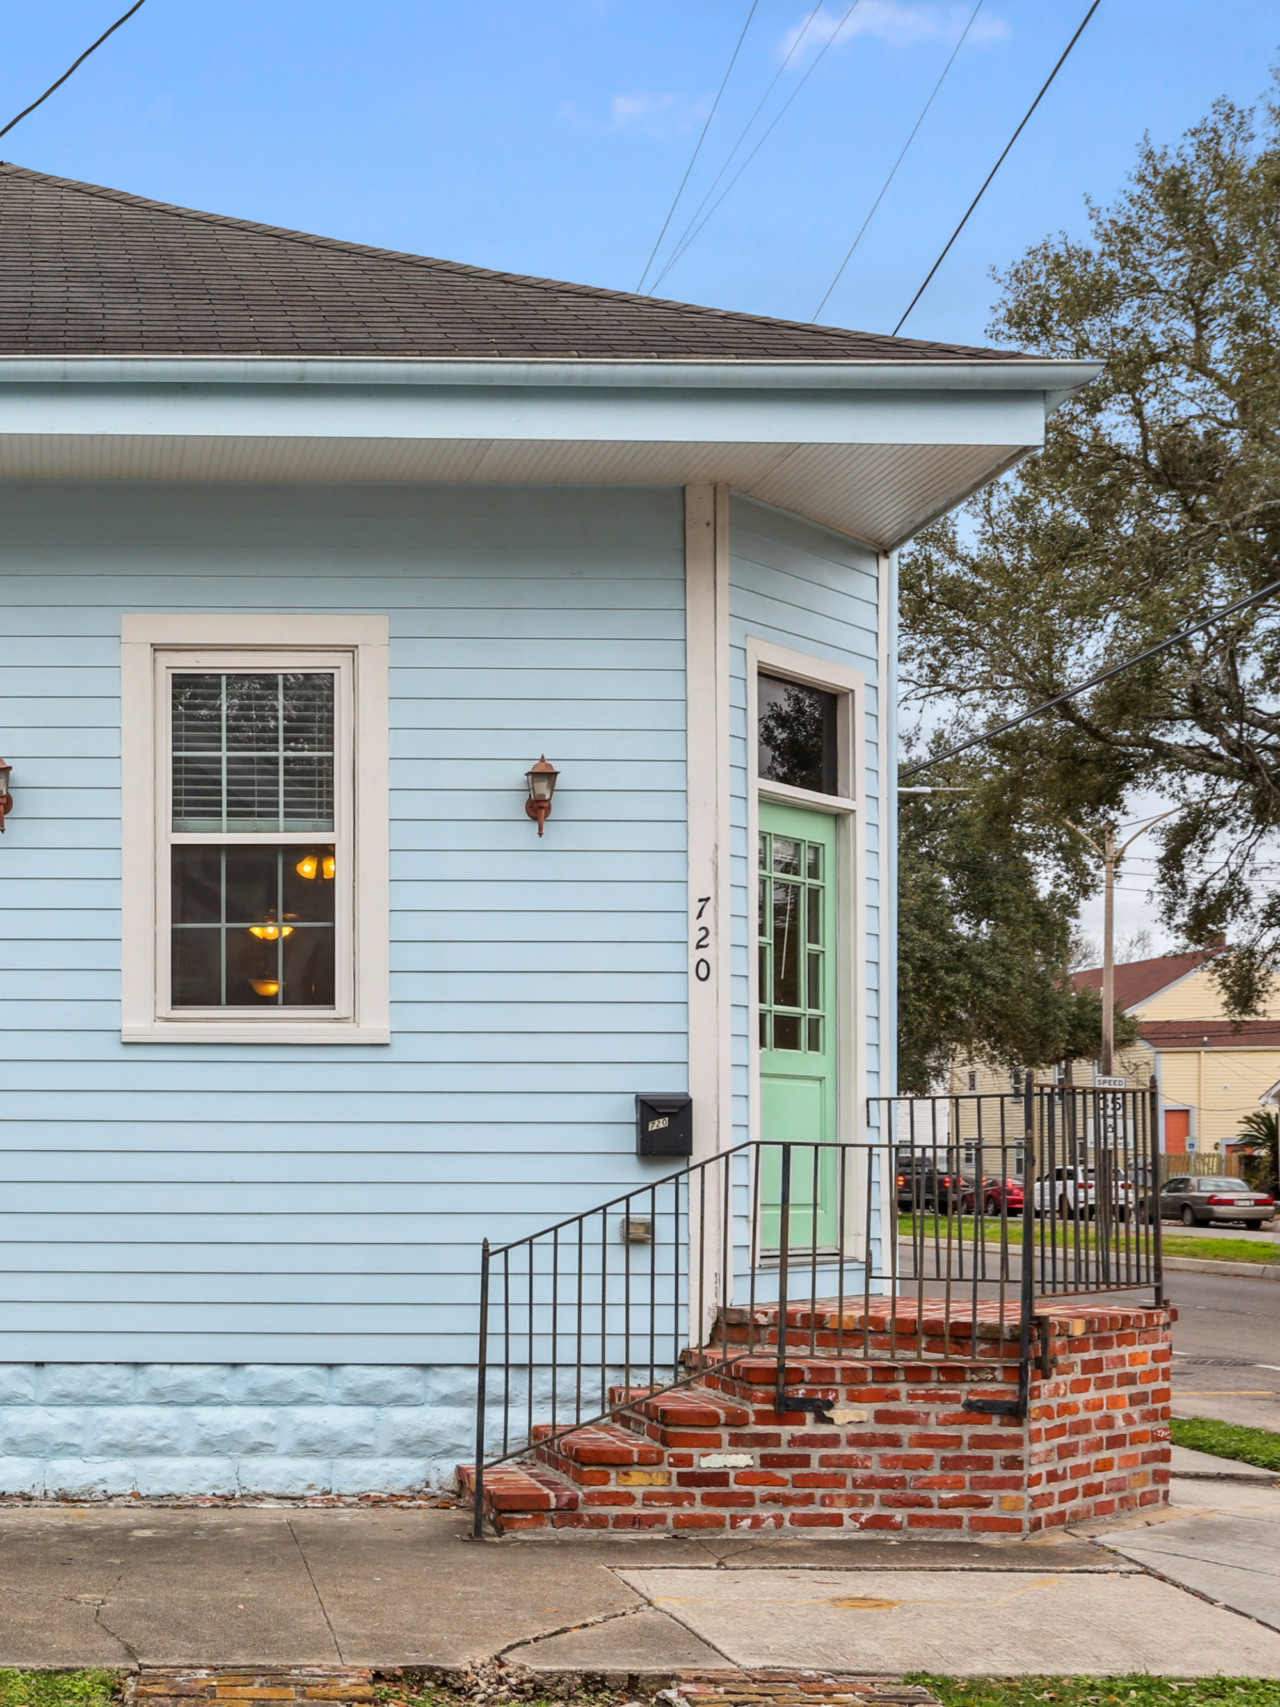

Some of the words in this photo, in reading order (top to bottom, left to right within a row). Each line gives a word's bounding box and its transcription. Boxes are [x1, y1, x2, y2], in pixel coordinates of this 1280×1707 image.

[695, 896, 711, 982] 720
[1097, 1079, 1124, 1087] SPEED
[649, 1118, 668, 1130] 720
